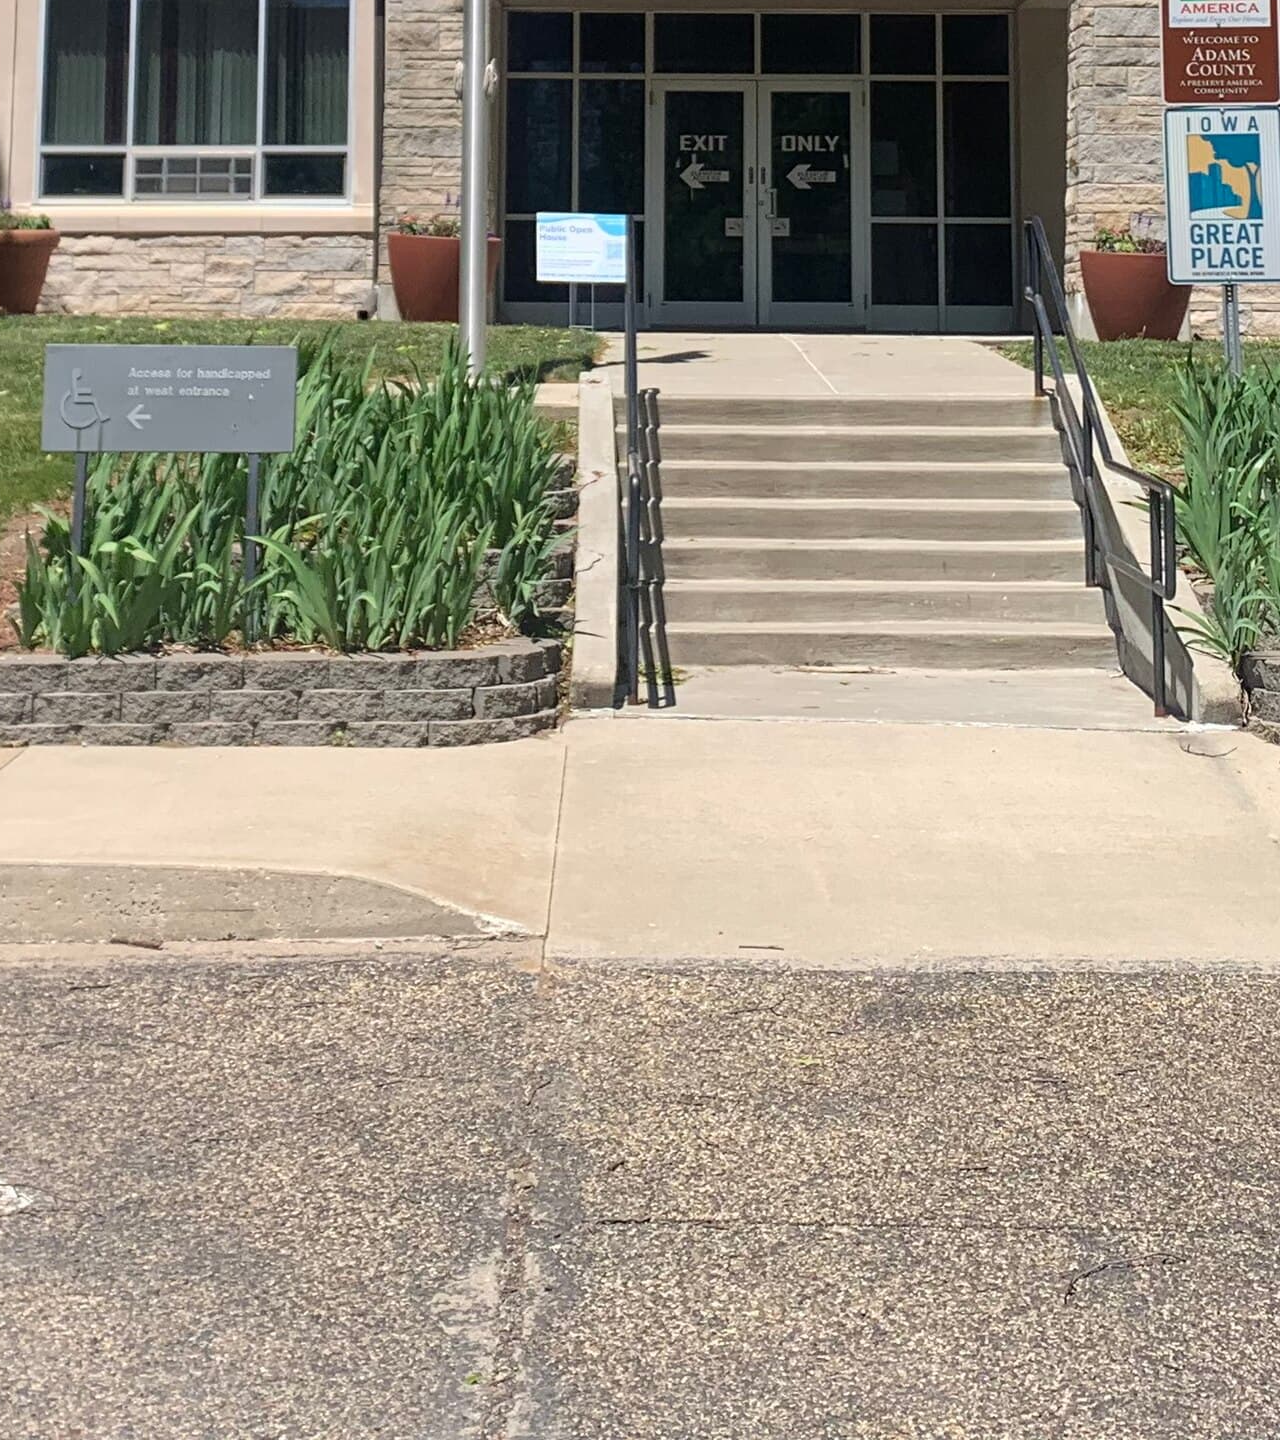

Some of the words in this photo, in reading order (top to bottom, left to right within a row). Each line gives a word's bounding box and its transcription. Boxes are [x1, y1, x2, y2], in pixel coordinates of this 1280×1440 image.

[1180, 3, 1260, 14] AMERICA
[1182, 36, 1240, 44] WELCOME
[1244, 35, 1259, 44] TO
[1191, 47, 1251, 61] ADAMS
[1186, 62, 1256, 77] COUNTY
[1186, 116, 1259, 132] IOWA
[679, 134, 728, 151] EXIT
[781, 135, 840, 152] ONLY
[1190, 223, 1264, 244] GREAT
[1191, 247, 1265, 269] PLACE
[128, 368, 170, 379] Access
[176, 368, 193, 379] for
[196, 368, 272, 381] handicapped
[127, 386, 139, 396] at
[145, 386, 174, 396] west
[179, 386, 230, 397] entrance
